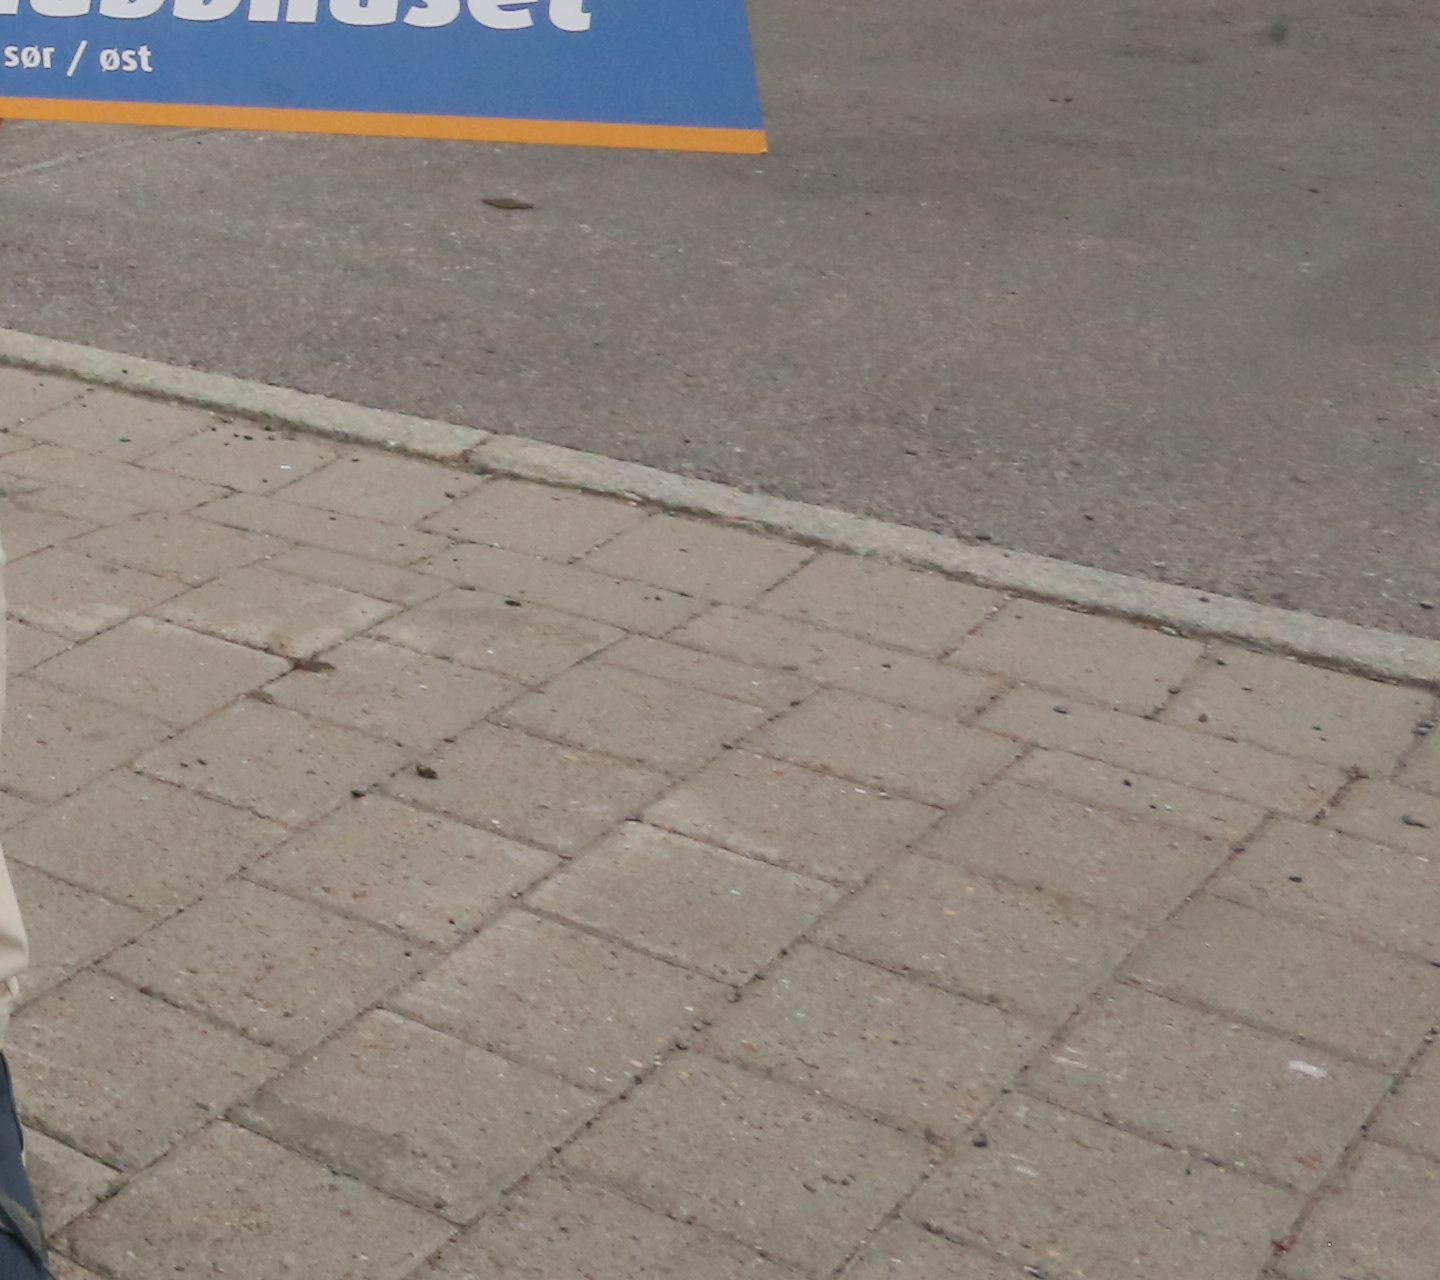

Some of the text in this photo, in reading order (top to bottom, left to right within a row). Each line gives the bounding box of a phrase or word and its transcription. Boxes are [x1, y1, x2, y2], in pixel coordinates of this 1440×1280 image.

[4, 46, 55, 68] sør
[67, 40, 87, 76] /
[100, 46, 152, 72] øst
